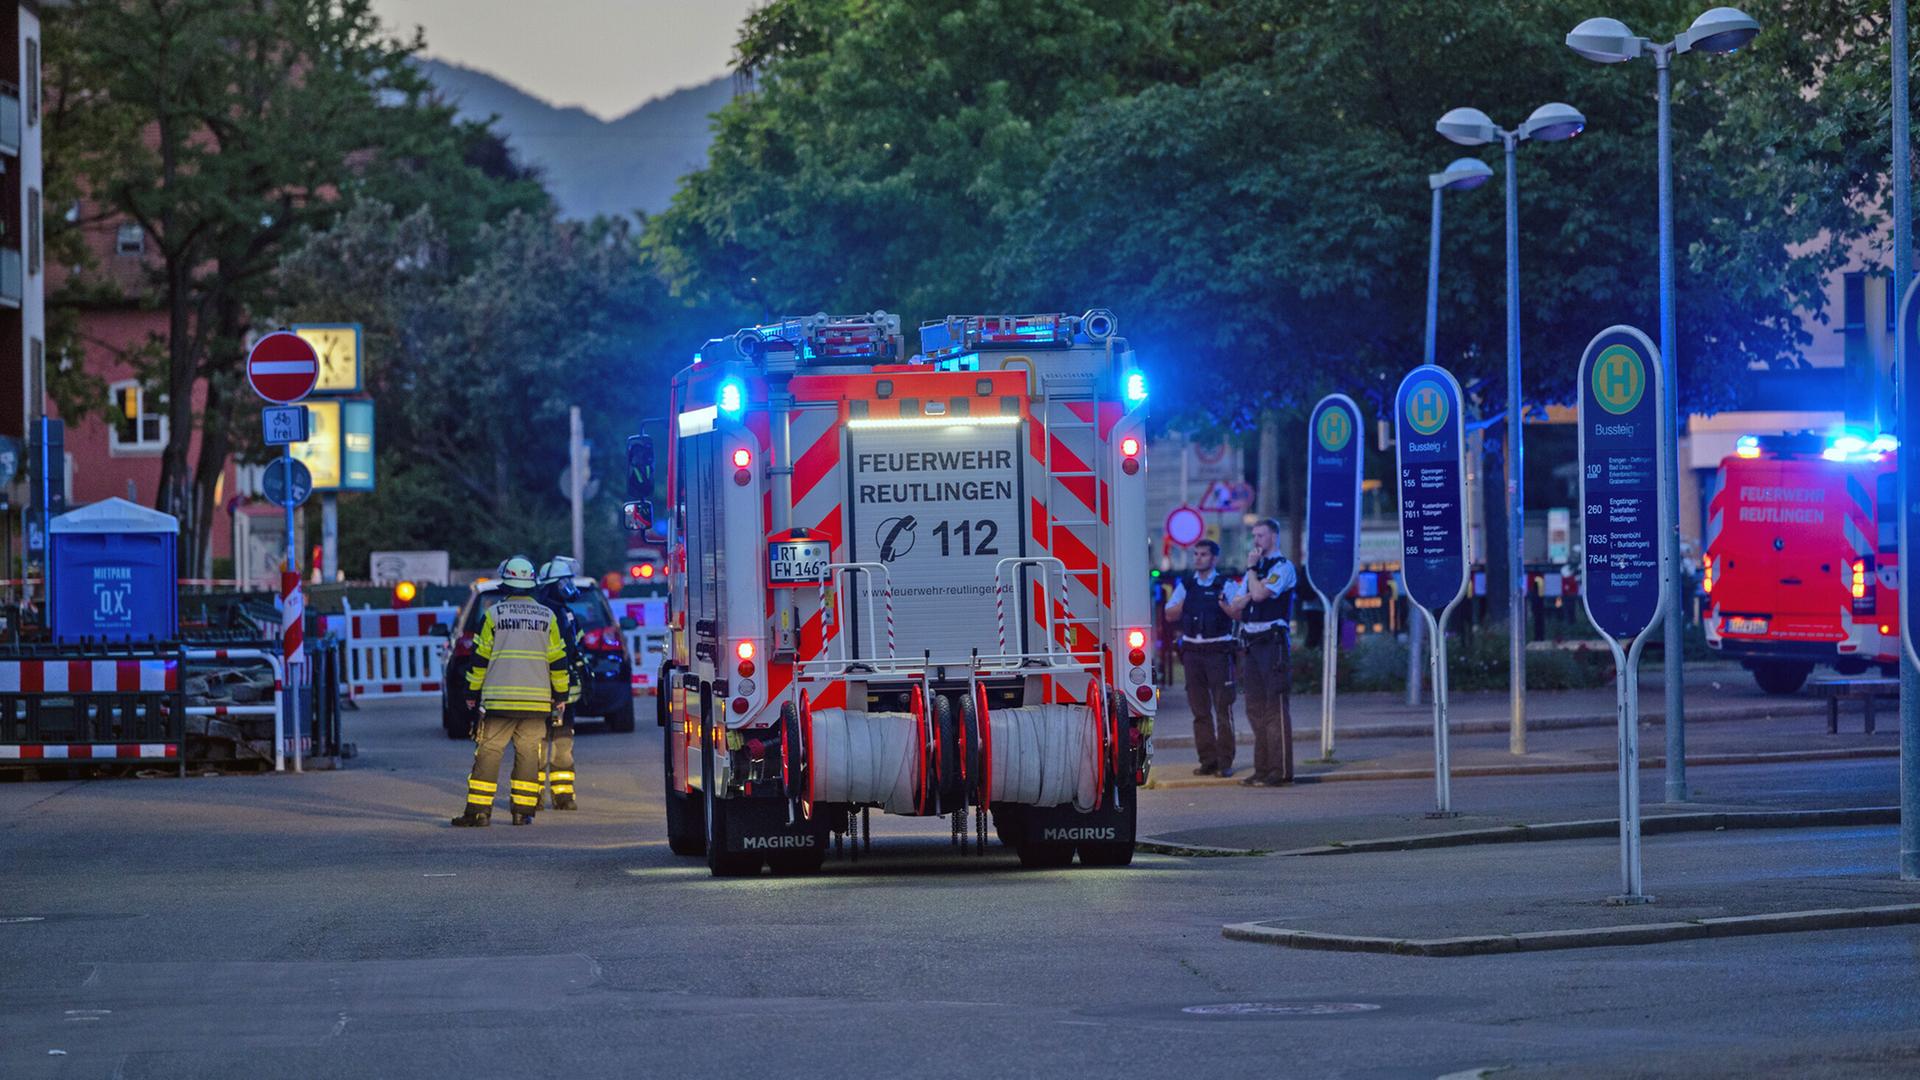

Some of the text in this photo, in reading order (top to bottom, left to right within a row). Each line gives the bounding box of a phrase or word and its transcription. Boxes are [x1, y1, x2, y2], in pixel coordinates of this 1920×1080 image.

[1607, 362, 1631, 396] H
[1417, 392, 1438, 422] H
[273, 429, 292, 439] frei
[1326, 416, 1343, 441] H
[1595, 423, 1634, 437] Bussteig
[1409, 441, 1441, 453] Bussteig
[858, 450, 1012, 473] FEUERWEHR
[1587, 464, 1602, 474] 100
[1403, 479, 1416, 487] 155
[860, 481, 1012, 504] REUTLINGEN
[1740, 486, 1825, 503] FEUERWEHR
[1404, 510, 1420, 518] 7611
[1587, 504, 1603, 514] 260
[1739, 507, 1825, 523] REUTLINGEN
[932, 520, 999, 556] 112
[1406, 529, 1414, 537] 12
[1588, 534, 1608, 544] 7635
[781, 547, 798, 561] RT
[1406, 546, 1418, 554] 555
[1588, 554, 1608, 564] 7644
[94, 567, 131, 580] MIETPARK
[775, 562, 792, 577] FW
[862, 584, 1014, 598] wwwfeuerwehr-reutlingende
[509, 603, 549, 612] FEUERWEHR
[509, 608, 550, 618] REUTLINGEN
[1043, 827, 1116, 840] MAGIRUS
[743, 835, 815, 849] MAGIRUS
